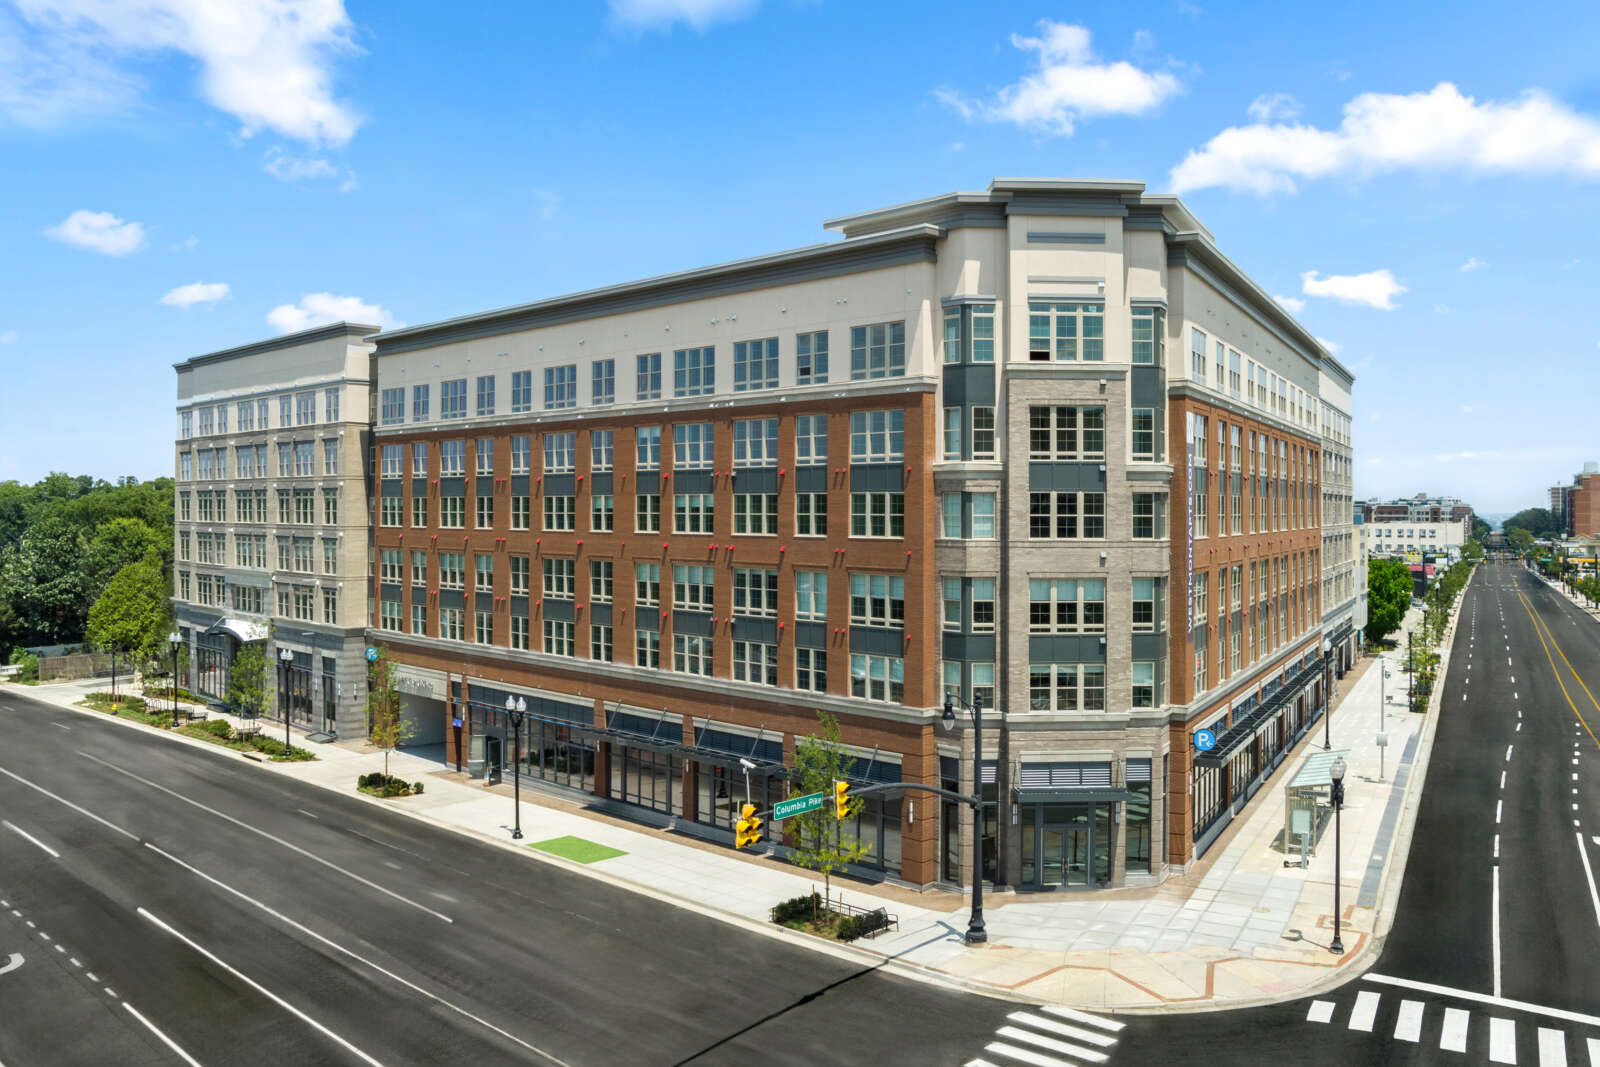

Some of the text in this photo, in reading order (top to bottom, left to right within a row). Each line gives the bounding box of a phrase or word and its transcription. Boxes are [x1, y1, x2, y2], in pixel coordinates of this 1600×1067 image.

[1198, 732, 1209, 747] P
[775, 797, 822, 815] Columbia Pike
